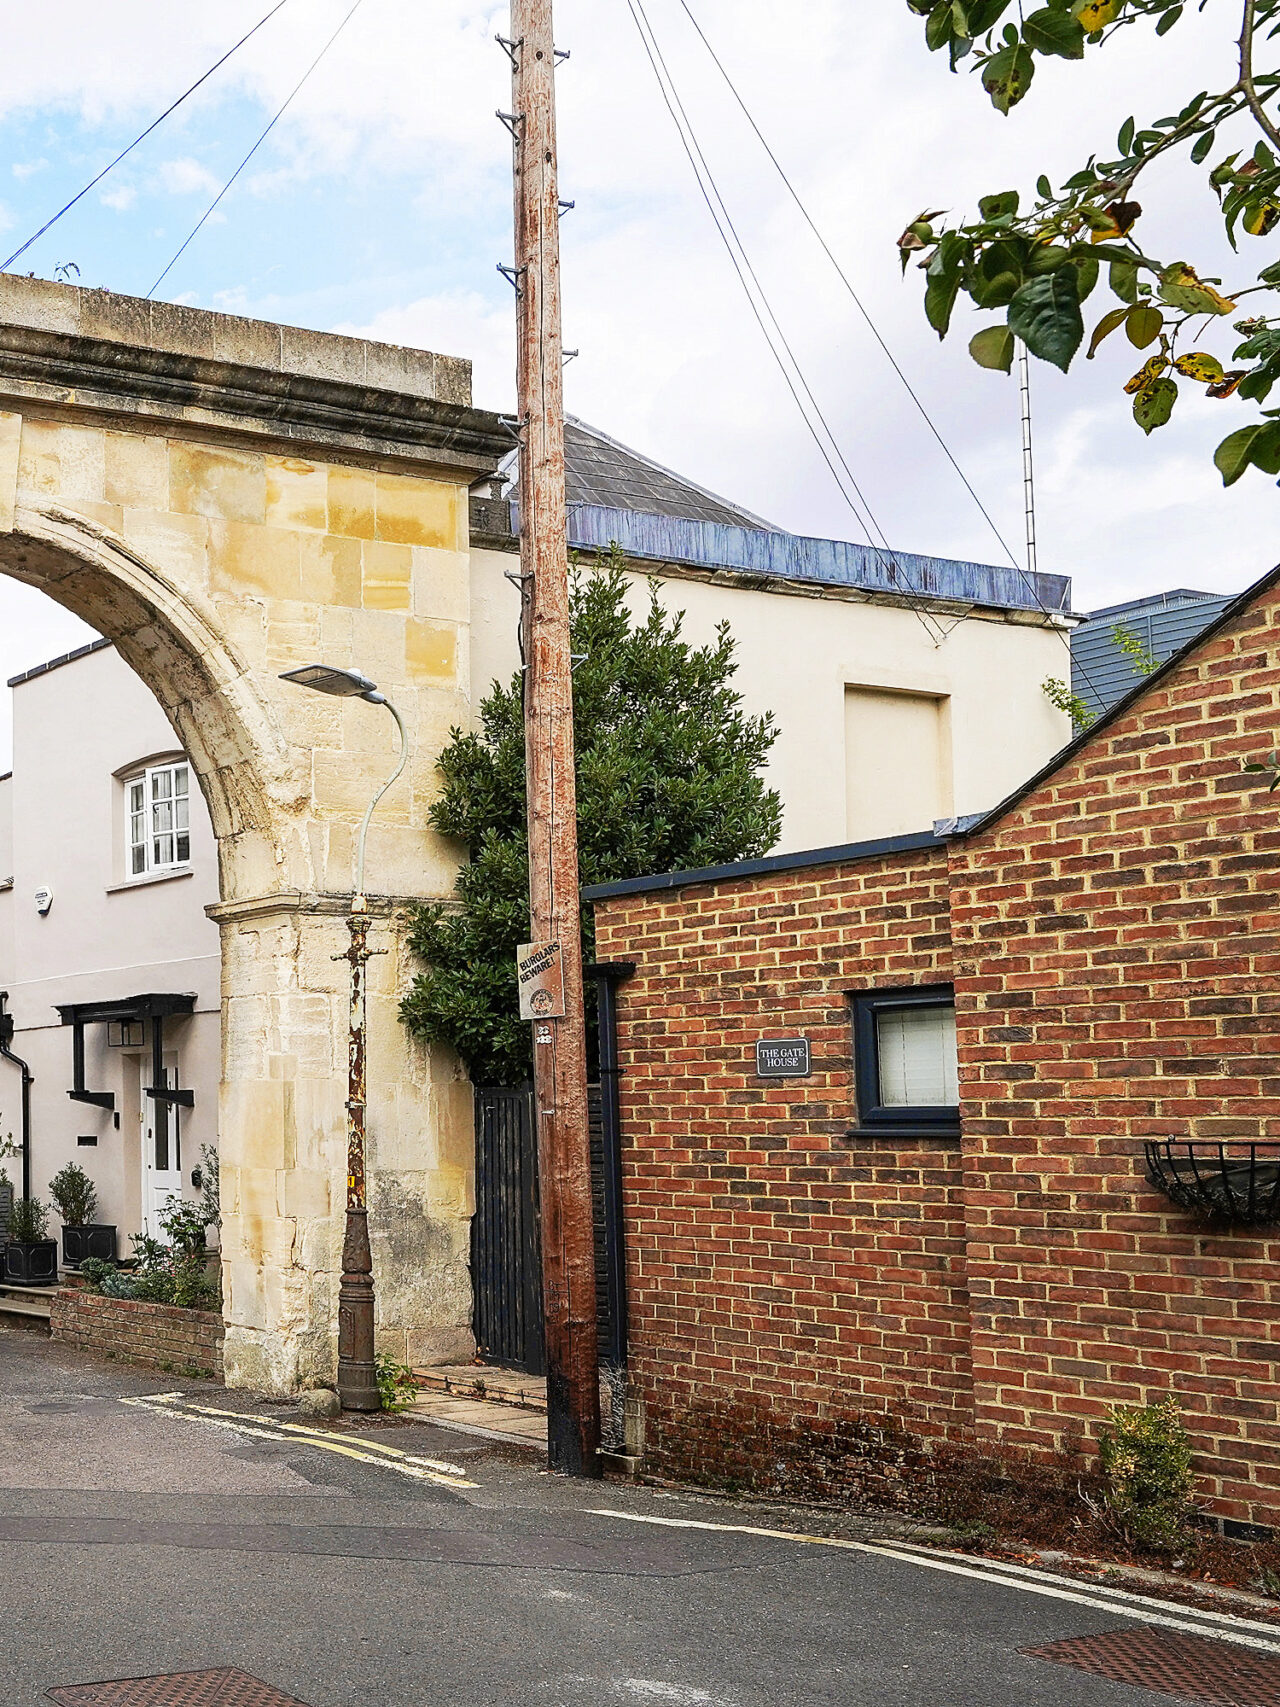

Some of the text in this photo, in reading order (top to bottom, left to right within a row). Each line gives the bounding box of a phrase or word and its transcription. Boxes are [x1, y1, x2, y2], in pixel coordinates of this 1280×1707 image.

[519, 942, 560, 971] BURGLARS
[519, 957, 556, 984] BEWARE!
[760, 1048, 805, 1058] THE GATE
[767, 1058, 799, 1067] HOUSE
